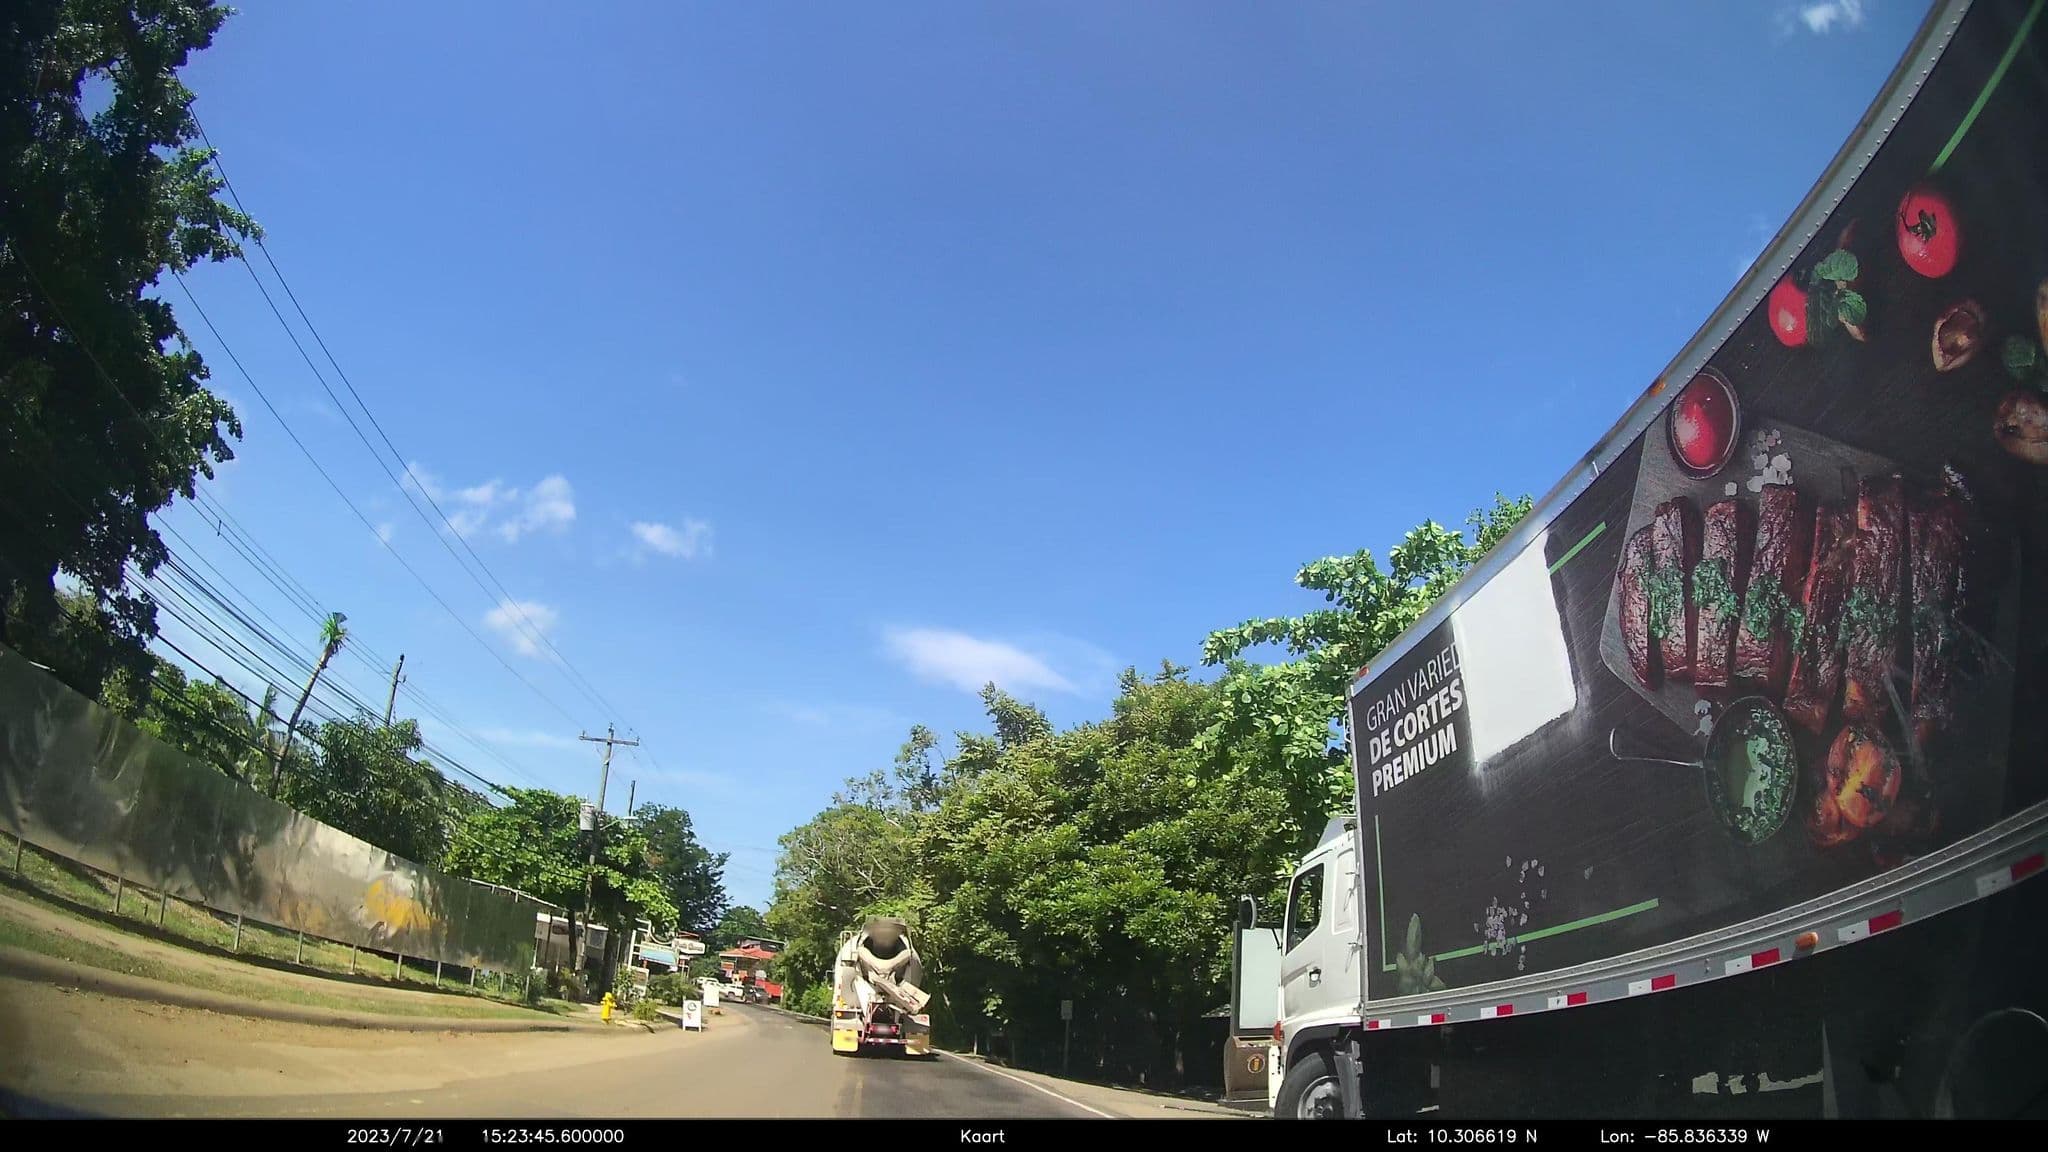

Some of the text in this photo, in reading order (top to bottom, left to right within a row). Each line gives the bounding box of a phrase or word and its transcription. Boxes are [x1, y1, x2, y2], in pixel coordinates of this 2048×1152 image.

[1367, 683, 1407, 731] GRAN
[1369, 678, 1463, 765] DE CORTES
[1372, 723, 1457, 797] PREMIUM
